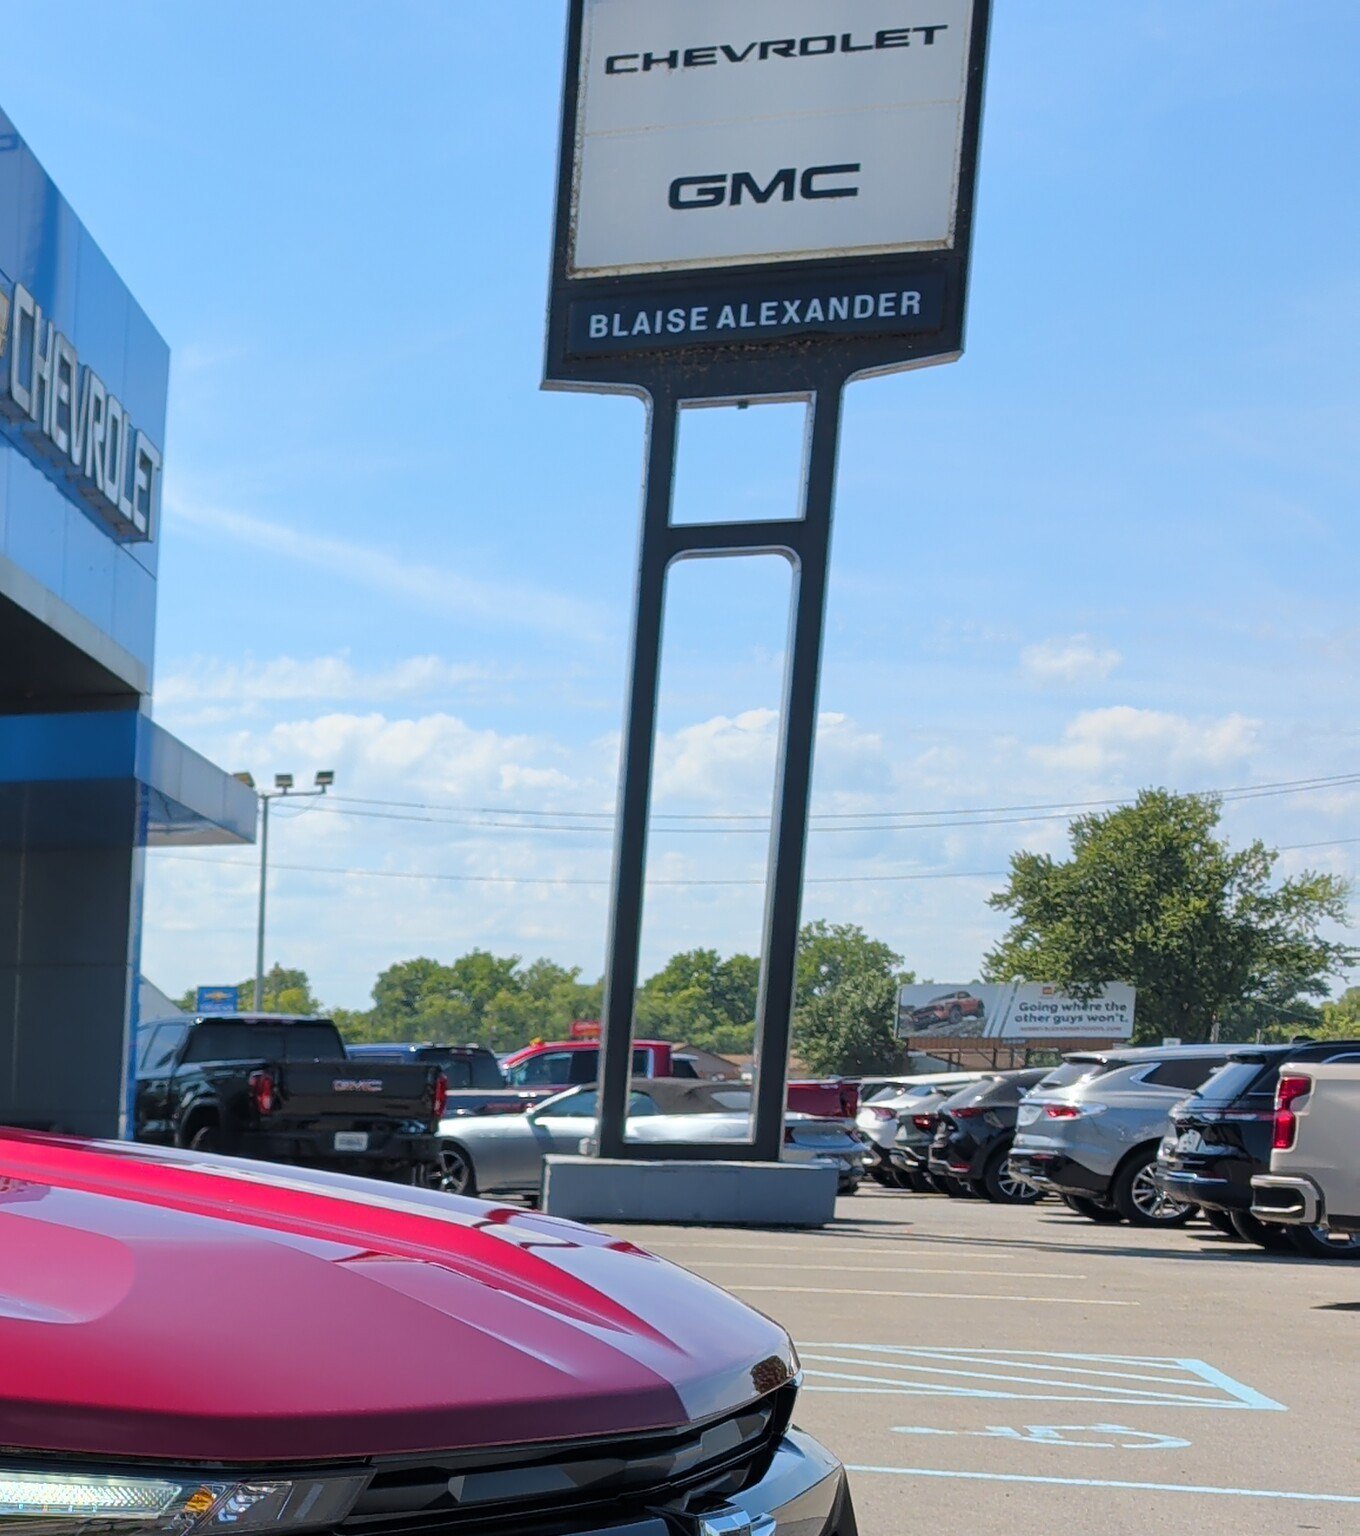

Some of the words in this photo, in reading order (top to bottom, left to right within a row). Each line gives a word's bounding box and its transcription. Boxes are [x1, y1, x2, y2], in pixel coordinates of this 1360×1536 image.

[605, 24, 949, 75] CHEVROLET
[668, 162, 861, 210] GMC
[588, 306, 708, 339] BLAISE
[716, 290, 922, 329] ALEXANDER
[8, 281, 161, 542] CHEVROLET
[1014, 1014, 1050, 1023] other
[1053, 1015, 1084, 1024] guys
[1087, 1013, 1129, 1023] won't.
[1018, 1001, 1059, 1013] Going
[1061, 1001, 1102, 1012] where
[1105, 1001, 1127, 1012] the
[333, 1079, 383, 1092] GMC
